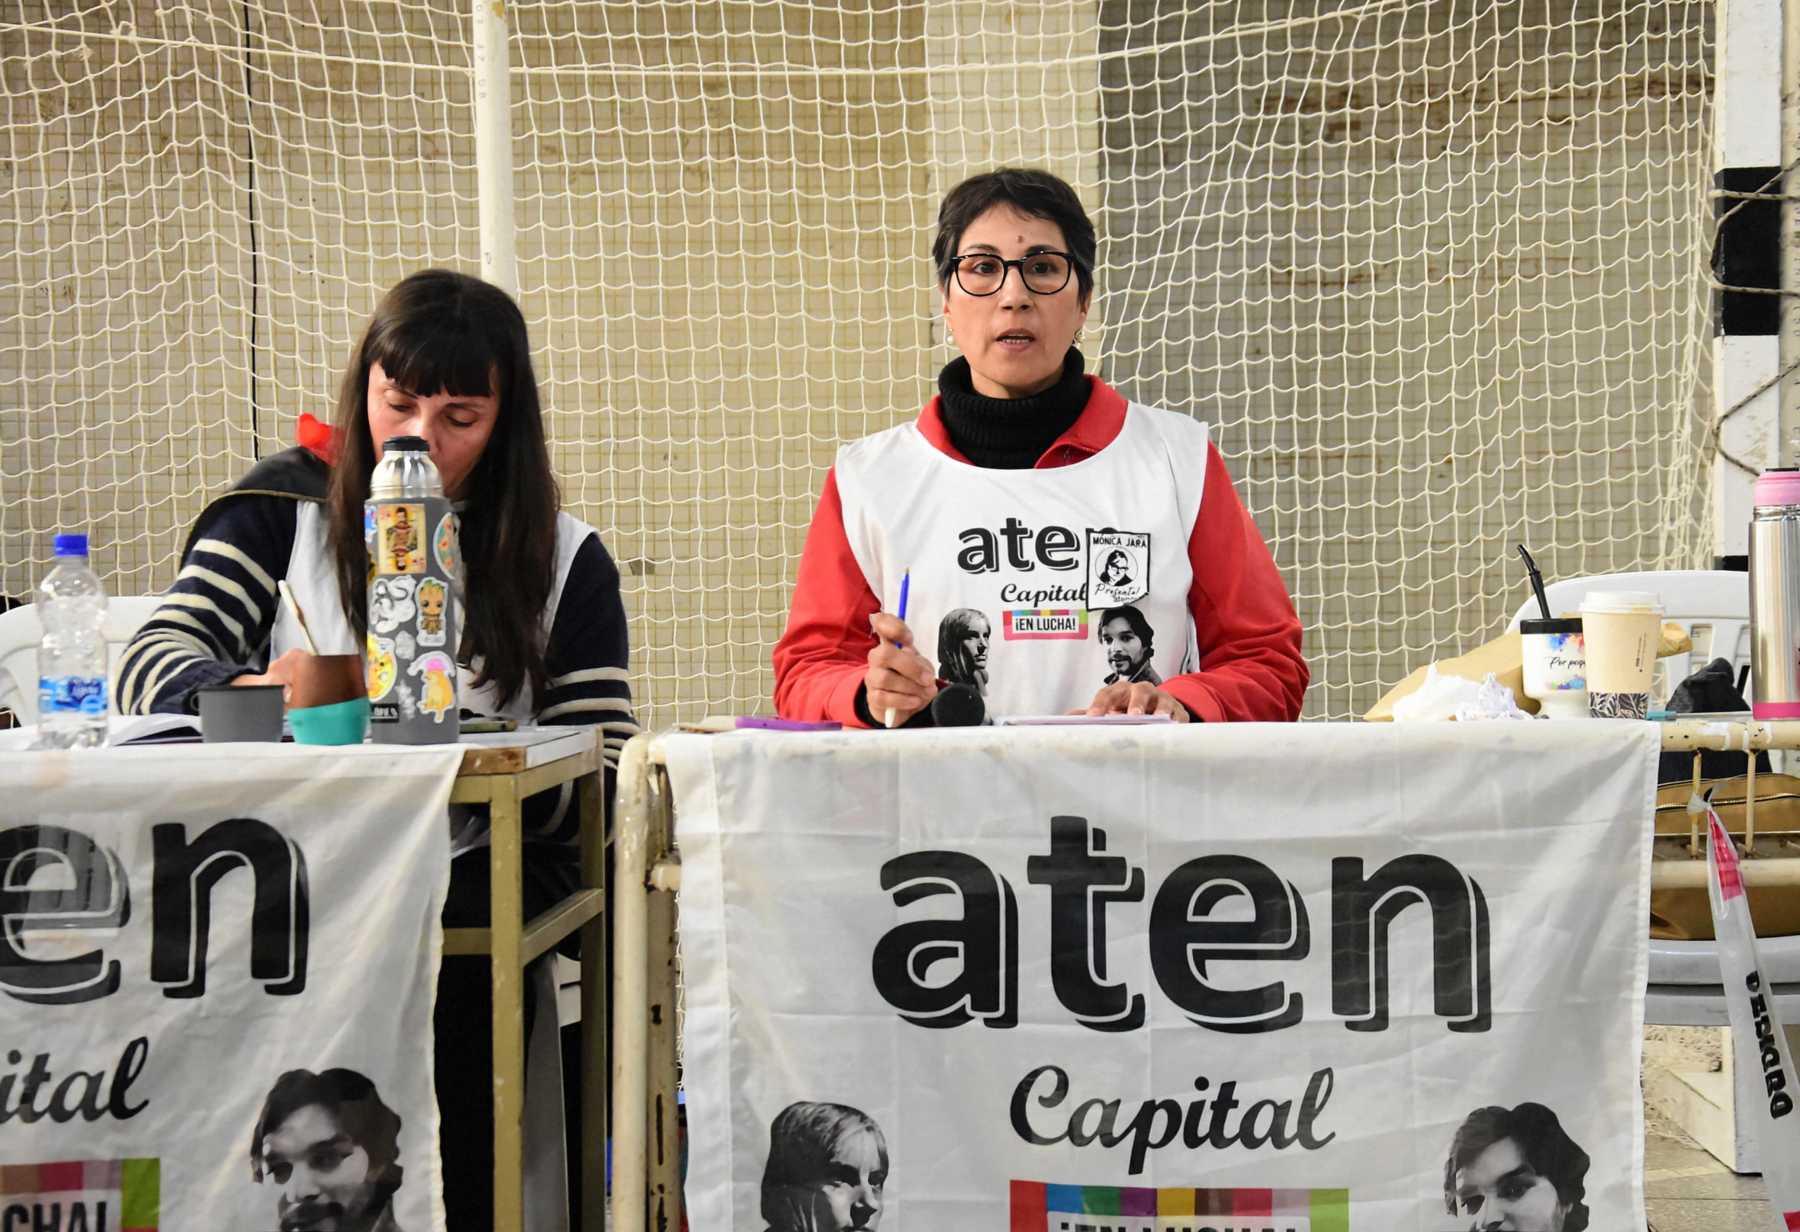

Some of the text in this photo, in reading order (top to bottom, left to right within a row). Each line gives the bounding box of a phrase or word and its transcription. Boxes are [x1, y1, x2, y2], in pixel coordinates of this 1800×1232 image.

[957, 517, 1118, 575] ate
[1015, 617, 1076, 631] ¡EN LUCHA!
[871, 815, 1492, 1034] aten
[1009, 1064, 1336, 1176] Capital
